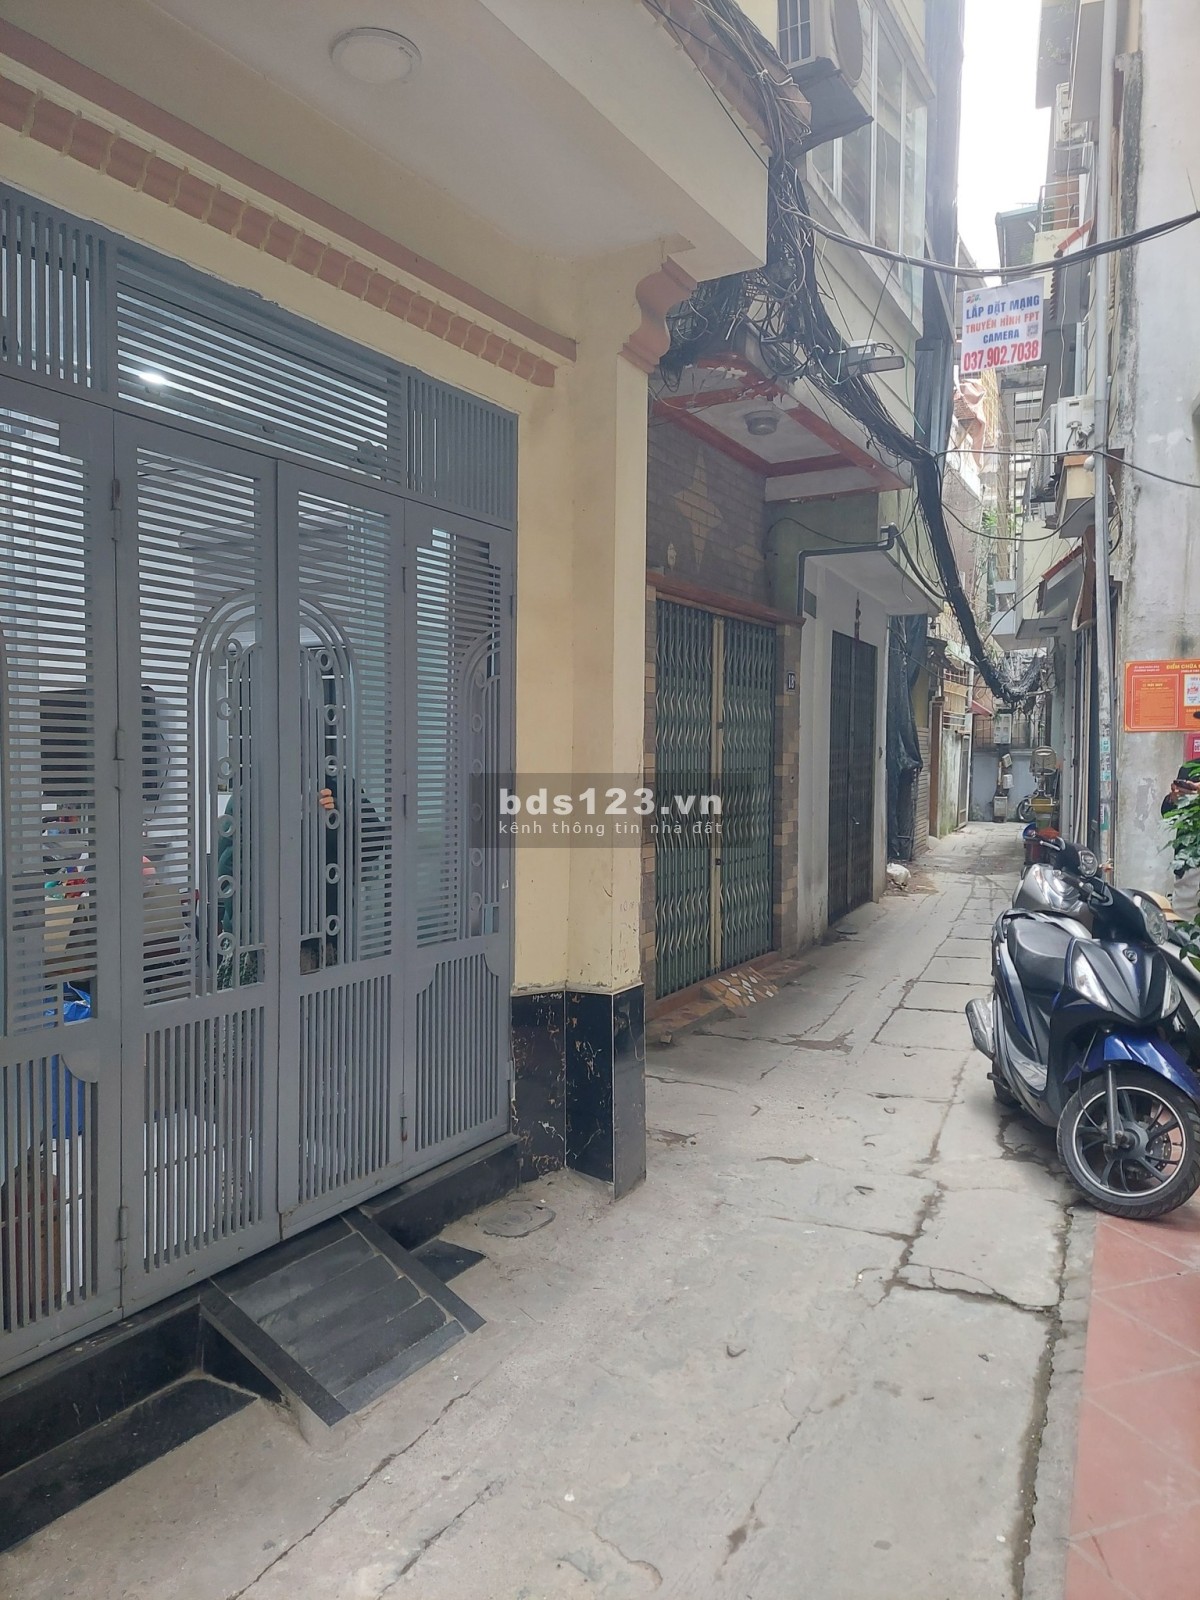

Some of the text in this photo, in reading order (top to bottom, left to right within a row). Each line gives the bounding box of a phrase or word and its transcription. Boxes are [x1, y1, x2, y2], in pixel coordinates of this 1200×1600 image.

[1009, 295, 1040, 311] MẠNG
[1024, 311, 1040, 323] FPT
[983, 330, 1019, 344] CAMERA
[964, 340, 1039, 371] 037.902.7038
